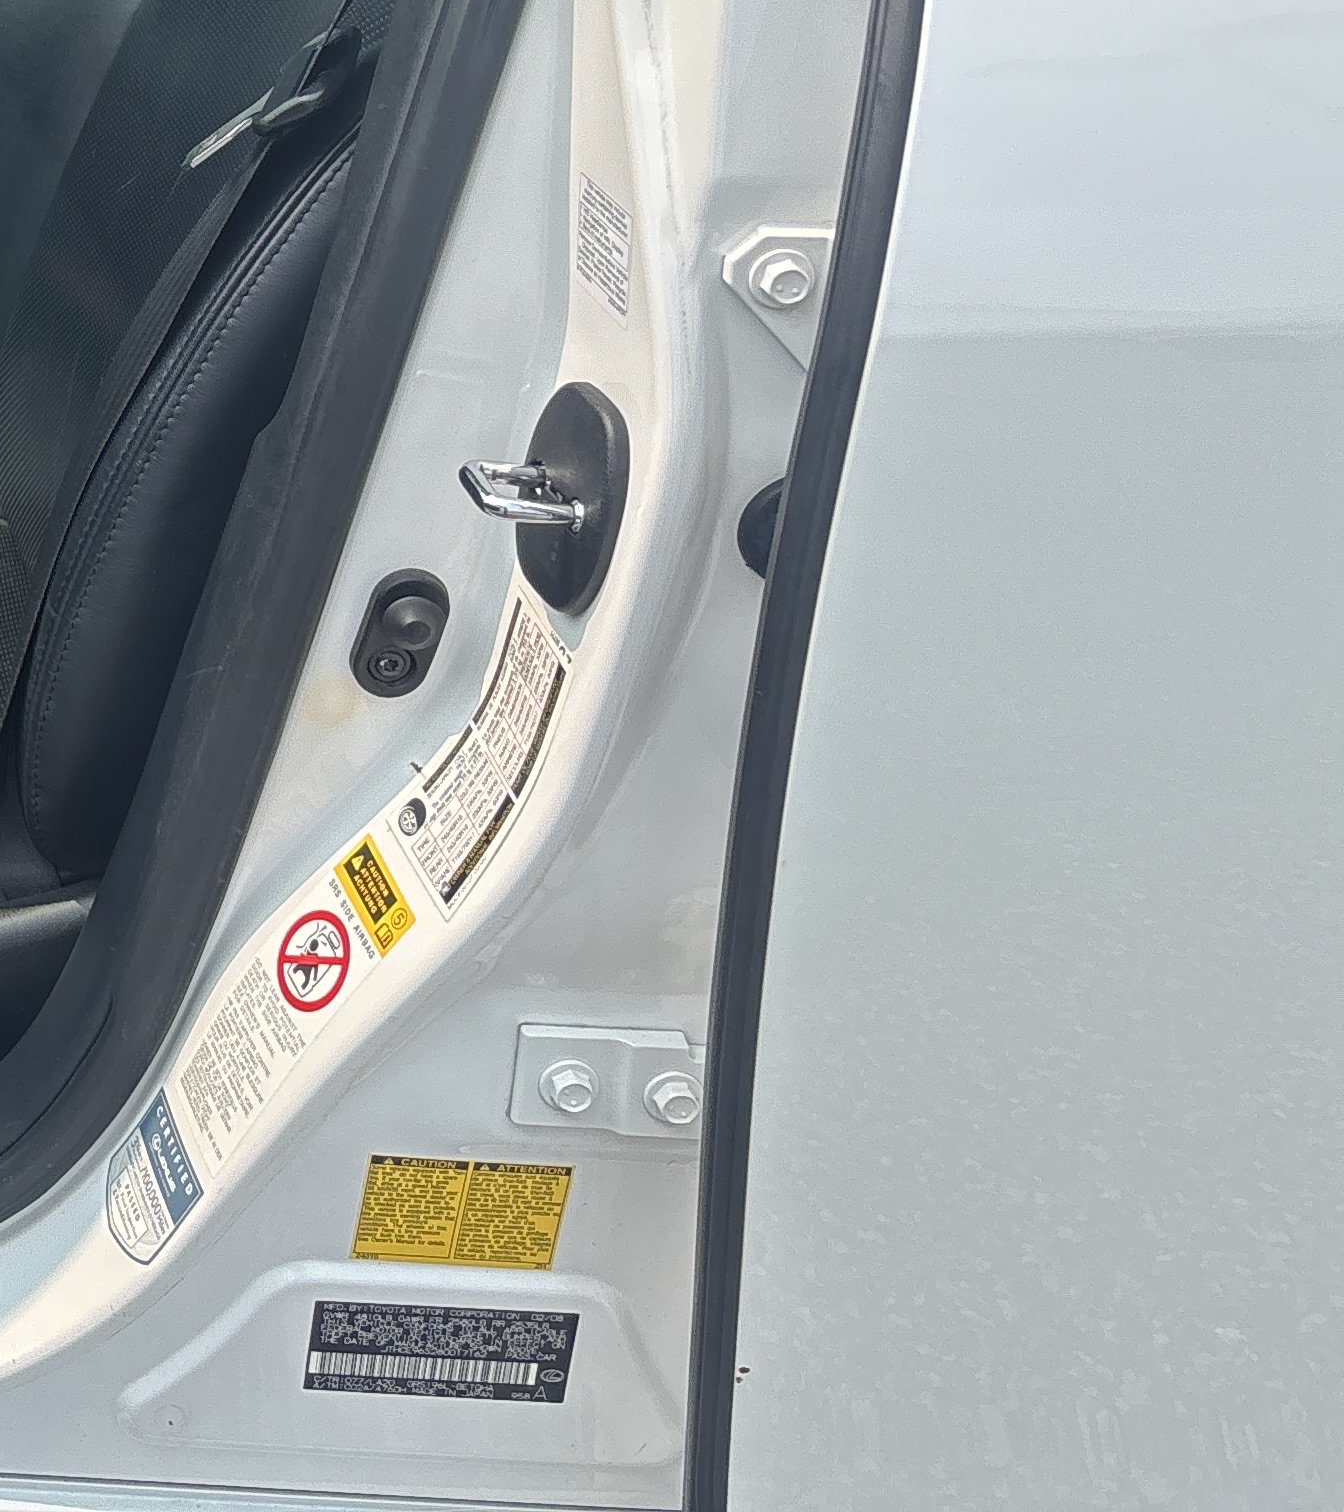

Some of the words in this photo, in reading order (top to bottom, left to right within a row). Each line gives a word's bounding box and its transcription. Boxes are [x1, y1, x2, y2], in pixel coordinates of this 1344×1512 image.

[352, 872, 378, 914] ACHTUNG
[359, 865, 387, 913] ATTENTION
[366, 858, 389, 898] CAUTION
[328, 877, 342, 899] SRS
[339, 899, 354, 921] SIDE
[353, 922, 375, 960] AIRBAG
[154, 1103, 194, 1197] CERTIFIED
[400, 1159, 457, 1168] CAUTION
[496, 1164, 567, 1175] ATTENTION
[124, 1183, 140, 1222] PASSED
[369, 1305, 406, 1314] TOYOTA
[412, 1308, 444, 1316] MOTOR
[449, 1309, 520, 1320] CORPORATION
[536, 1353, 557, 1361] CAR
[532, 1386, 547, 1400] A
